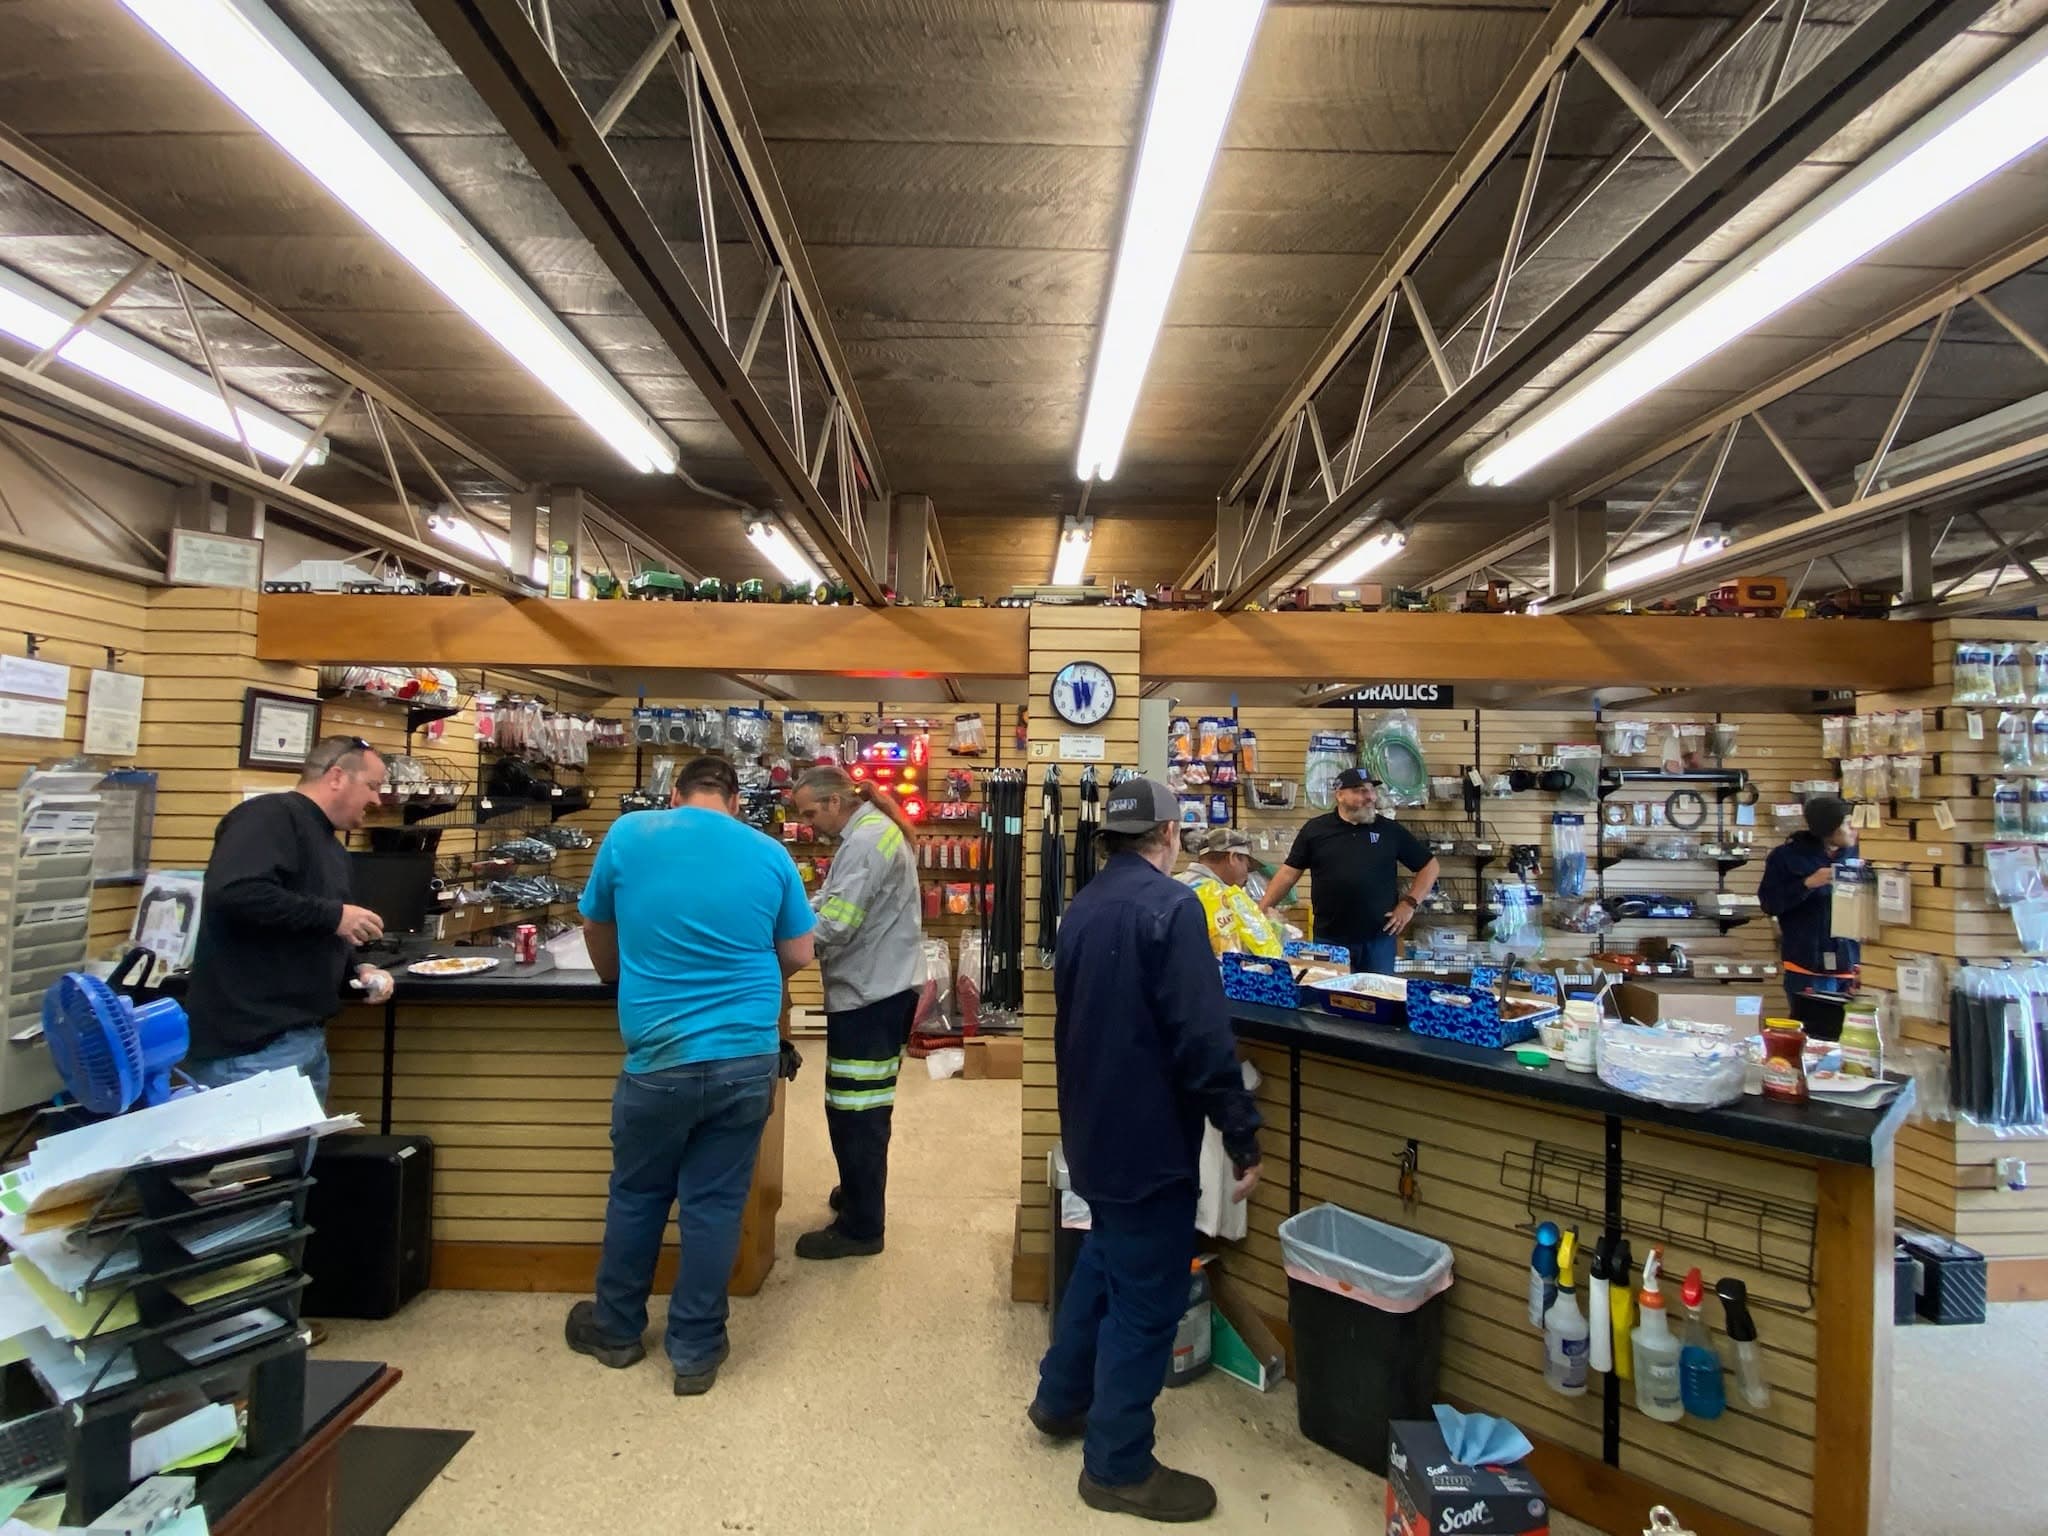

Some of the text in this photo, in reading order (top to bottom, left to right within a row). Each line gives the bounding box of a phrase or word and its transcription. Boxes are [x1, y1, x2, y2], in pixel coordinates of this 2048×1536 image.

[1073, 682, 1097, 712] W
[1341, 684, 1438, 700] DRAULICS
[1426, 1464, 1449, 1477] Scott
[1439, 1500, 1486, 1533] Scott
